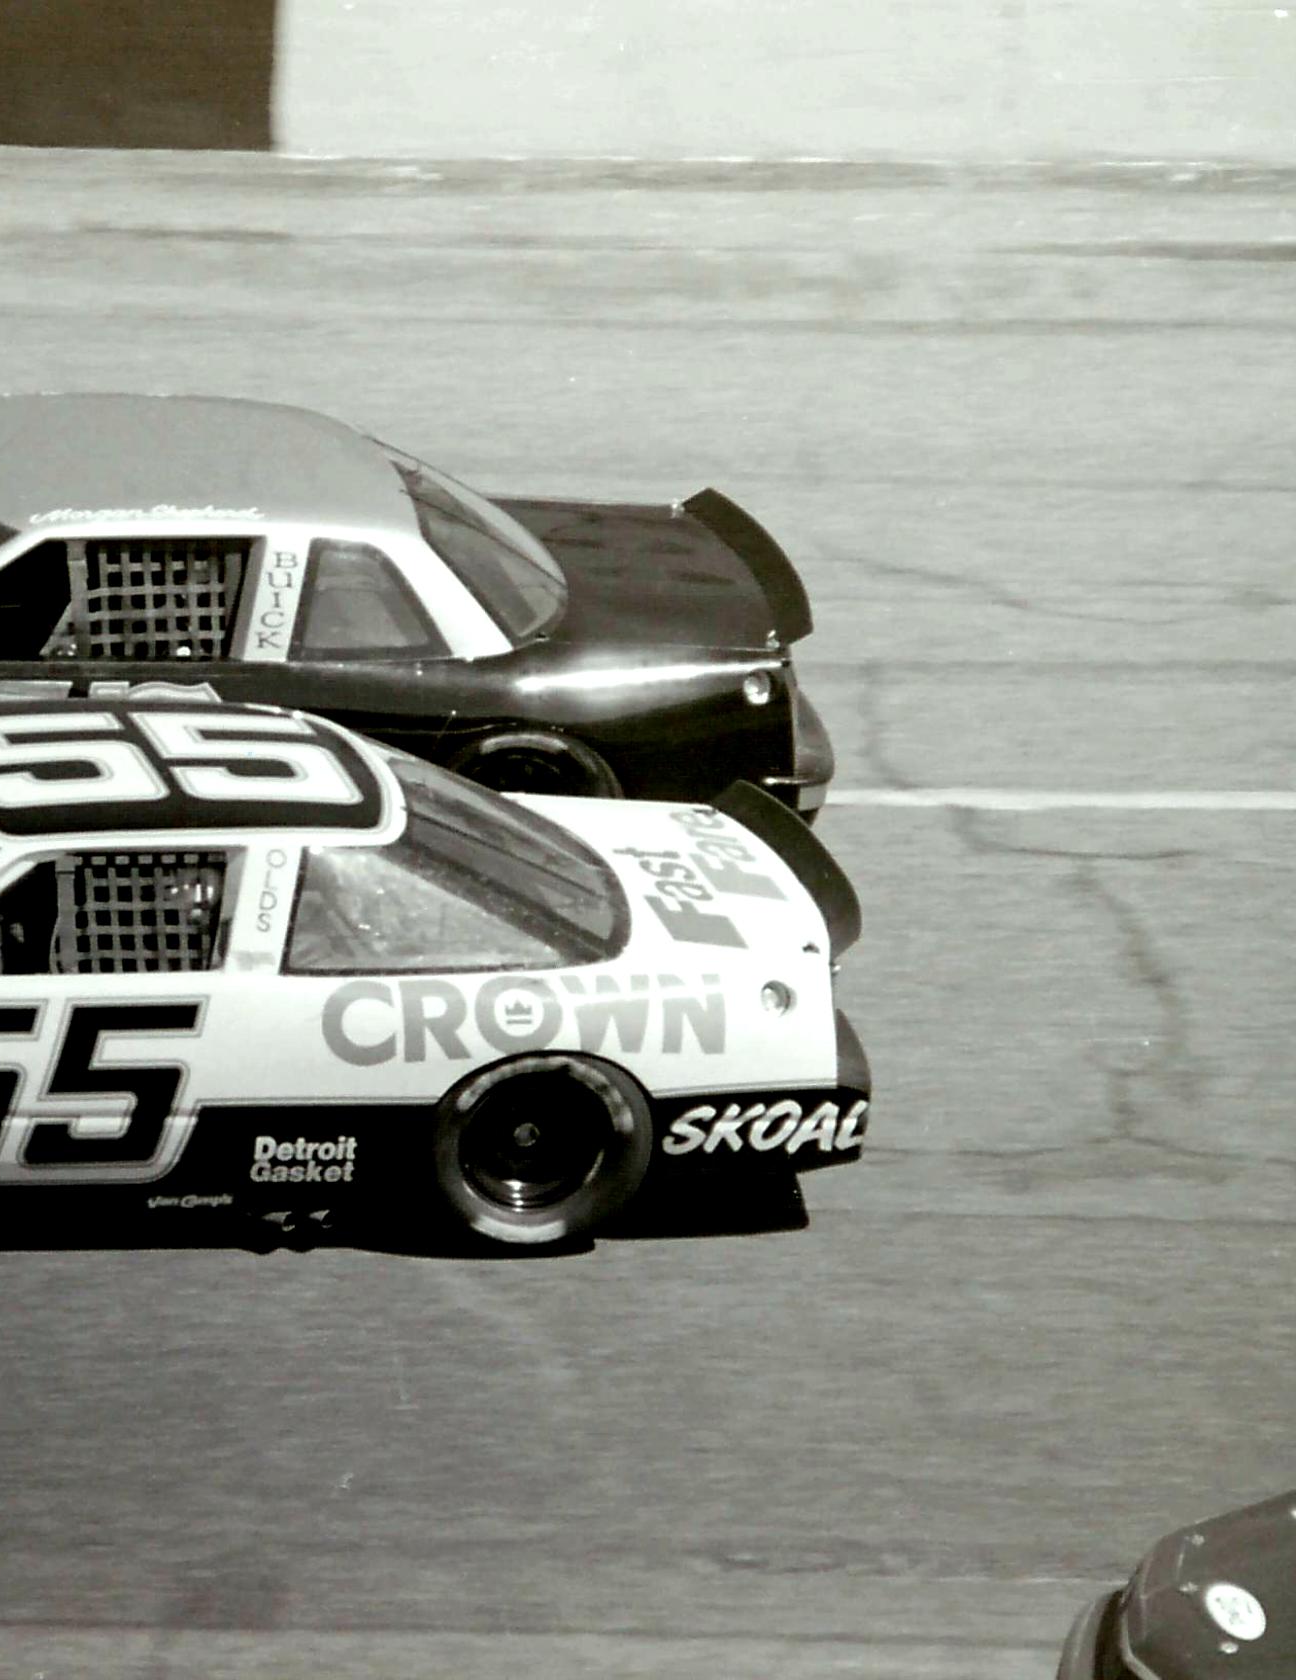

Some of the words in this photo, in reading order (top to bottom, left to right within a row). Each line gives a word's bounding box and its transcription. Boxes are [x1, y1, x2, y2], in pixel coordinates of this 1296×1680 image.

[256, 551, 299, 650] BUICK
[256, 849, 287, 932] OLDS
[613, 847, 749, 949] Fast
[669, 812, 788, 901] Fare
[321, 974, 726, 1066] CROWN
[253, 1135, 357, 1162] Detroit
[662, 1099, 870, 1155] SKOAL
[249, 1160, 355, 1184] Gasket
